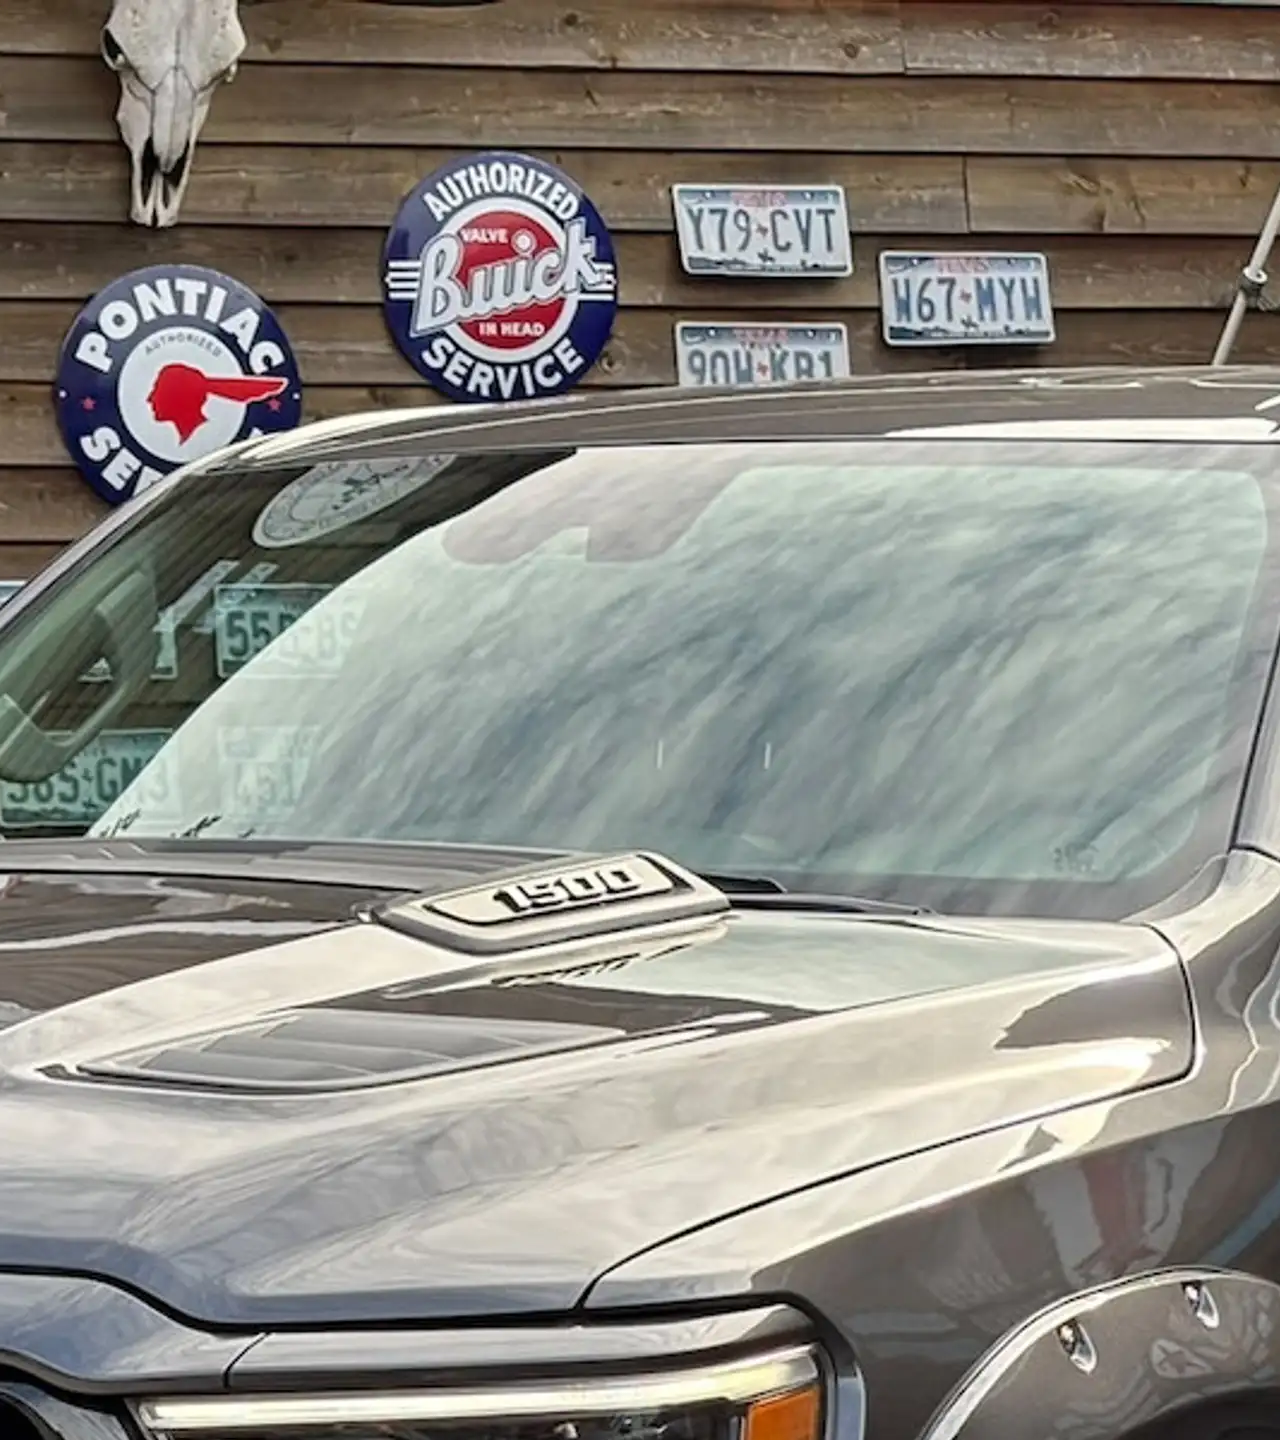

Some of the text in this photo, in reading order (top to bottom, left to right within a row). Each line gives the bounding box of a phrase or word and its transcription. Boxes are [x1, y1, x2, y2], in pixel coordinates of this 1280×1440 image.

[423, 162, 579, 221] AUTHORIZED
[460, 228, 509, 244] VALVE
[409, 217, 610, 338] Buick
[75, 278, 285, 375] PONTIAC
[145, 333, 222, 358] AUTHORIZED
[479, 322, 546, 337] IN HEAD
[422, 337, 586, 399] SERVICE
[493, 866, 642, 912] 1500
